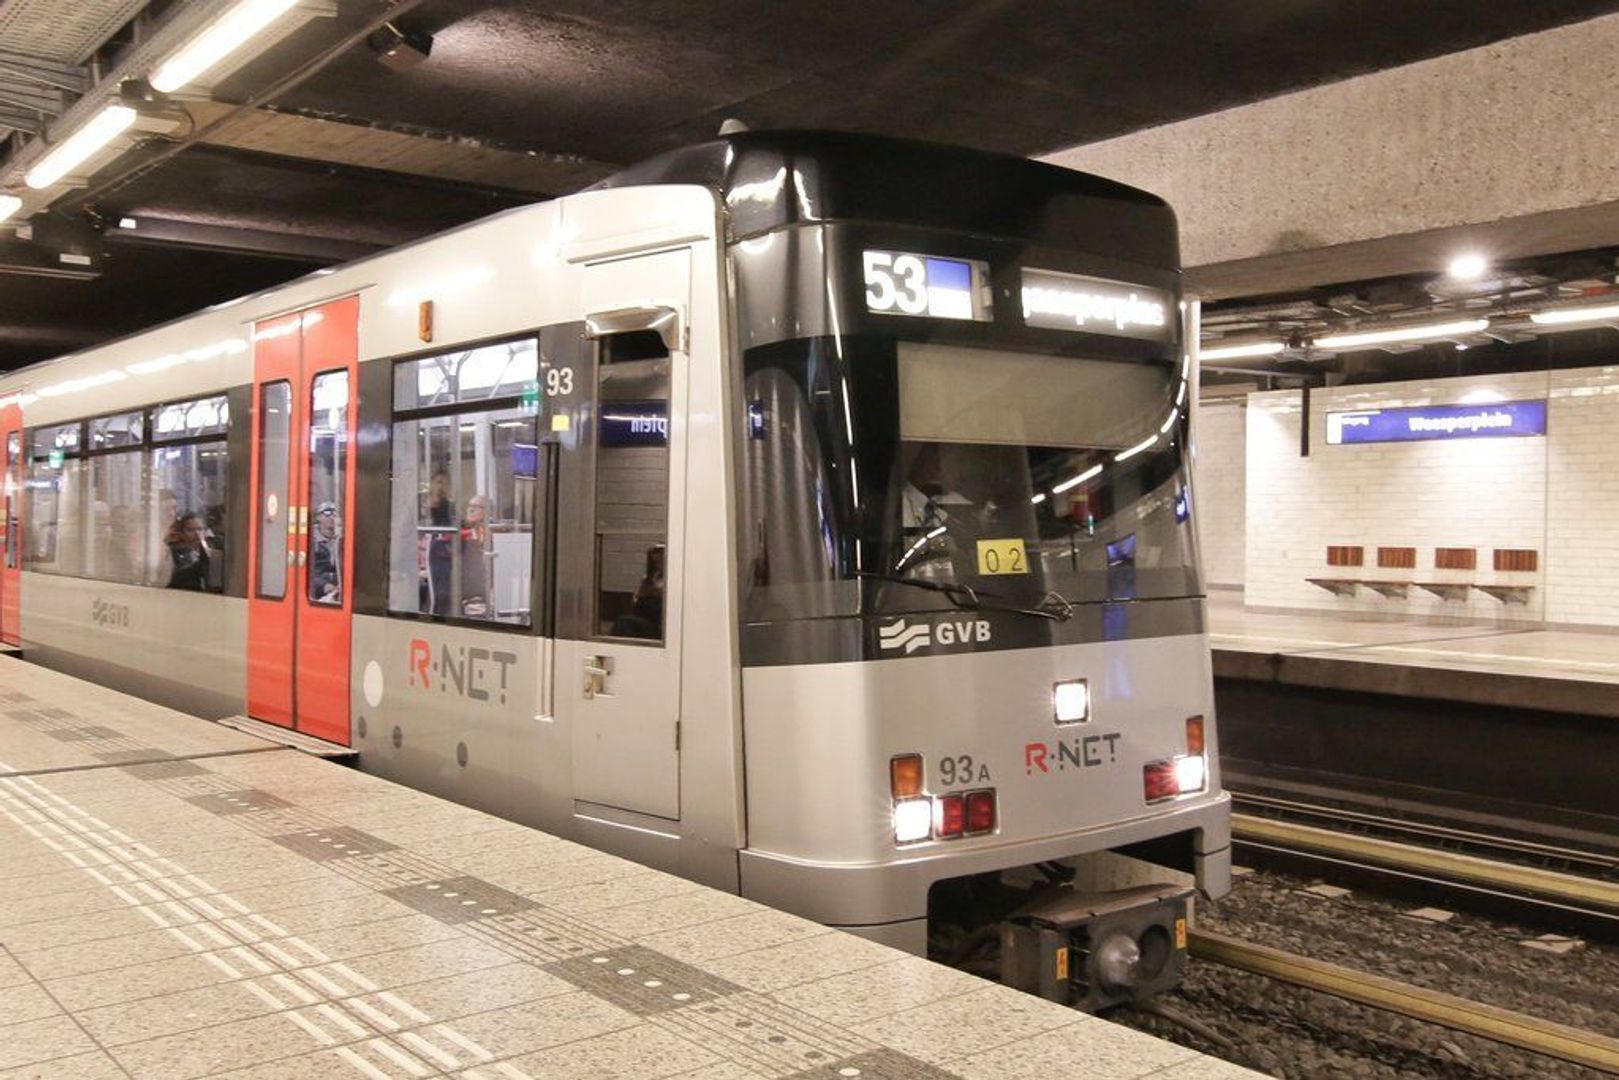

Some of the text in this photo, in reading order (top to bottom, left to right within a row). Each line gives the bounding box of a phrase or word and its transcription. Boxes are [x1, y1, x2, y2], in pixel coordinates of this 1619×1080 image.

[863, 251, 928, 313] 53
[547, 367, 574, 397] 93
[935, 620, 992, 646] GVB
